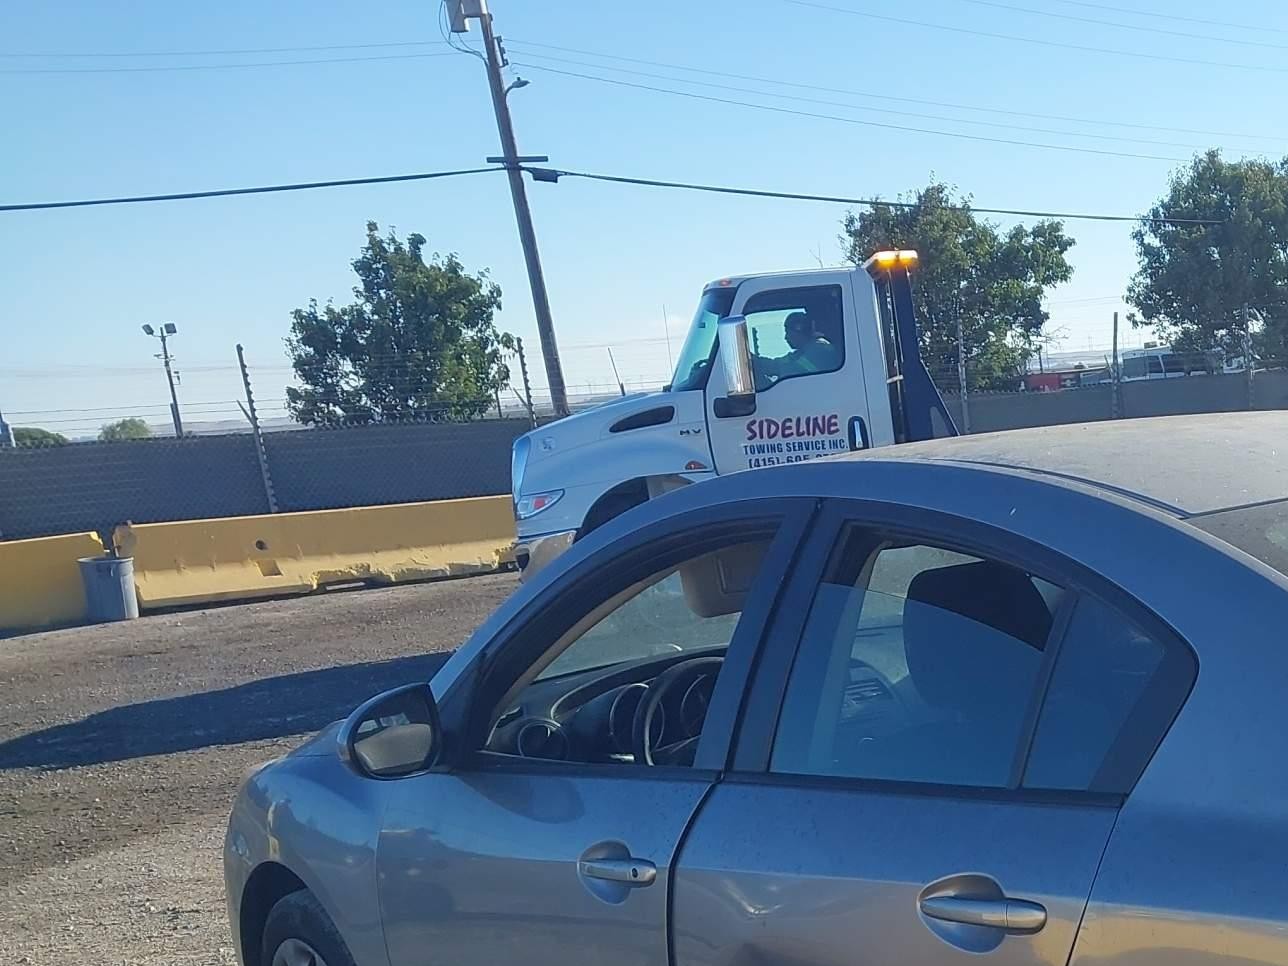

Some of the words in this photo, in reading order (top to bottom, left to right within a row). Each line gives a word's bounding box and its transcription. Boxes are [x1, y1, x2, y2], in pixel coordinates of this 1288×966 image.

[746, 414, 840, 440] SIDELINE
[743, 442, 783, 456] TOWING
[786, 440, 826, 452] SERVICE
[829, 438, 848, 450] INC.
